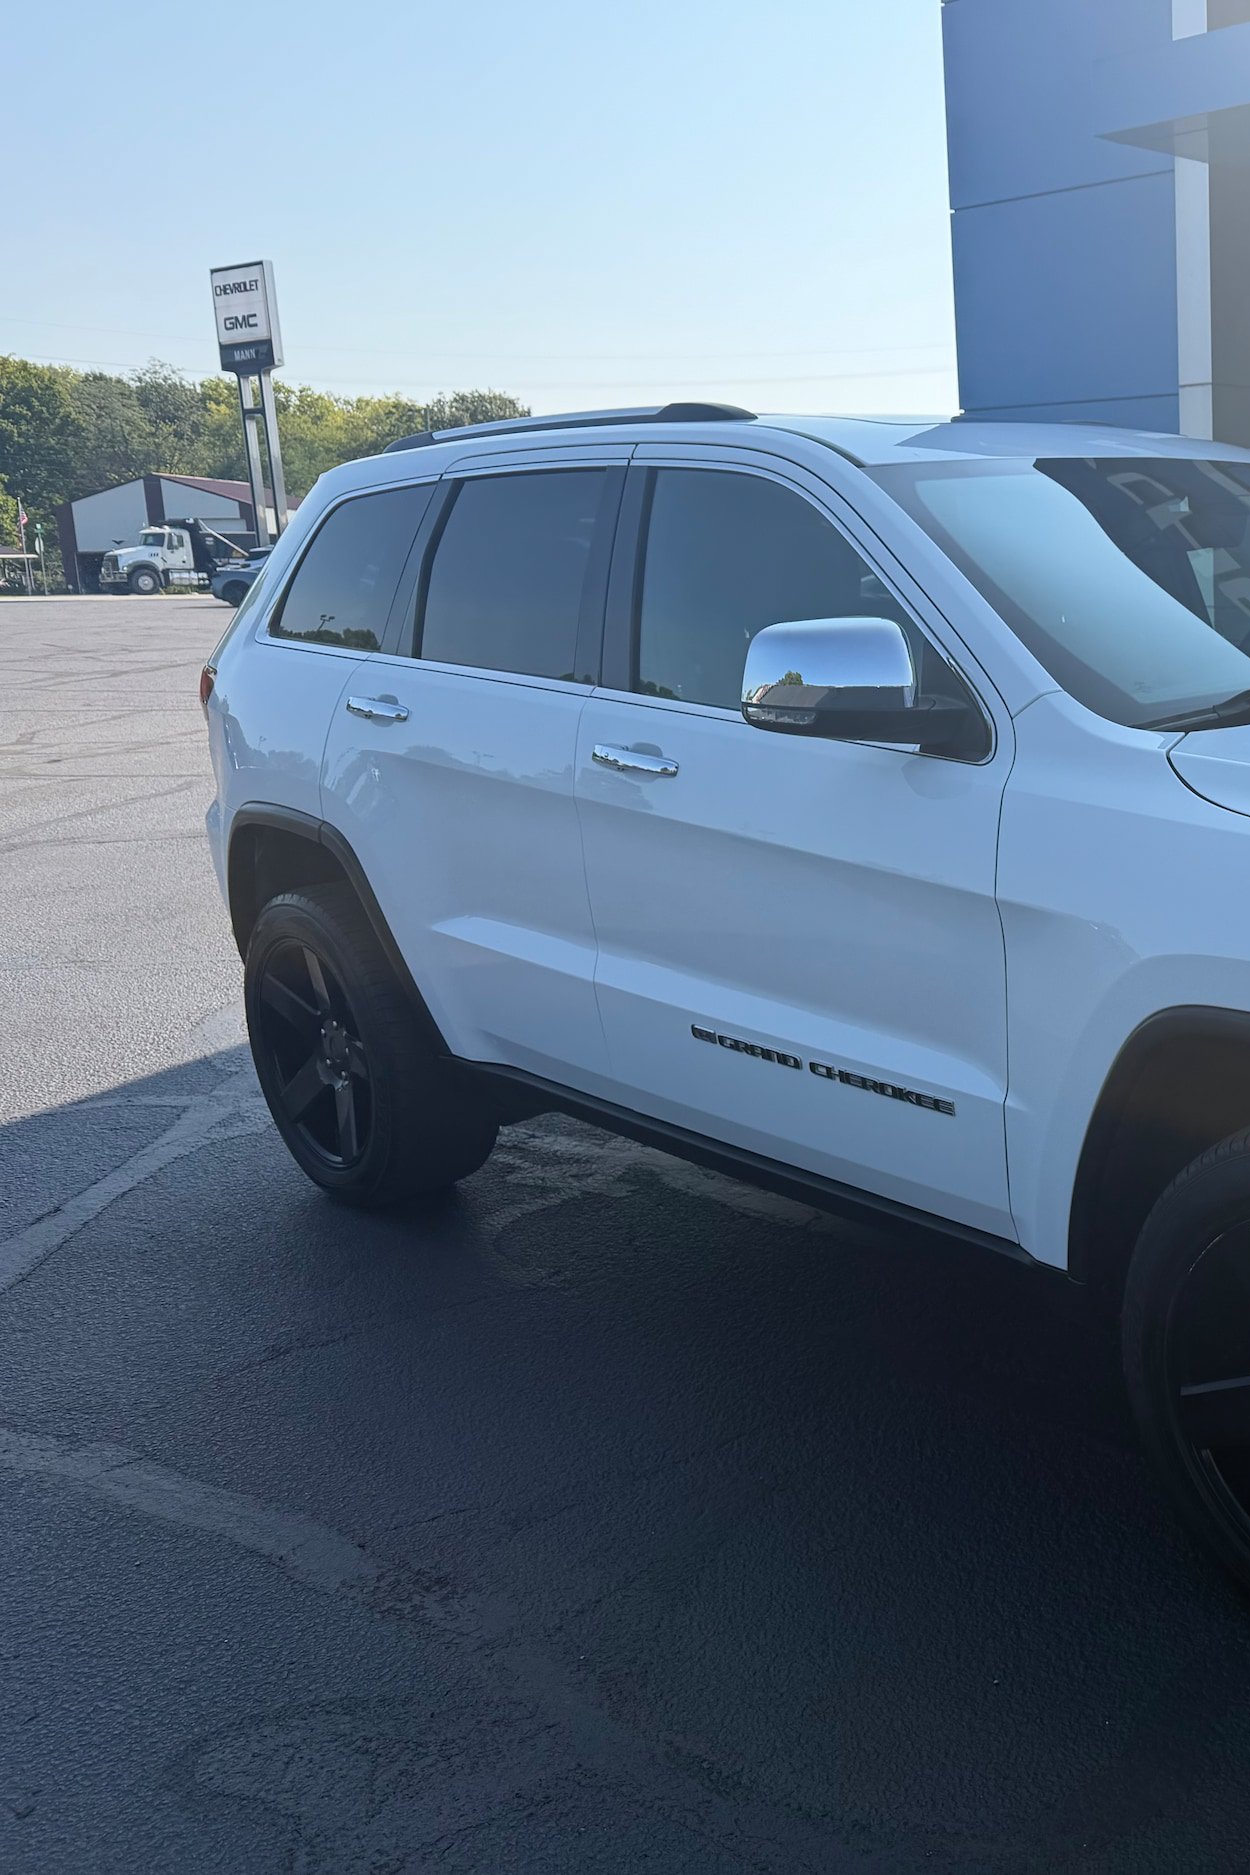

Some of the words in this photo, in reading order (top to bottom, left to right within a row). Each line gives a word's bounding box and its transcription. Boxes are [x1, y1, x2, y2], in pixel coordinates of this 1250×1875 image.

[214, 279, 259, 297] CHEVROLET
[223, 313, 258, 331] GMC
[233, 348, 256, 361] MANN
[717, 1034, 803, 1070] GRAND
[809, 1060, 956, 1117] CHEROKEE
